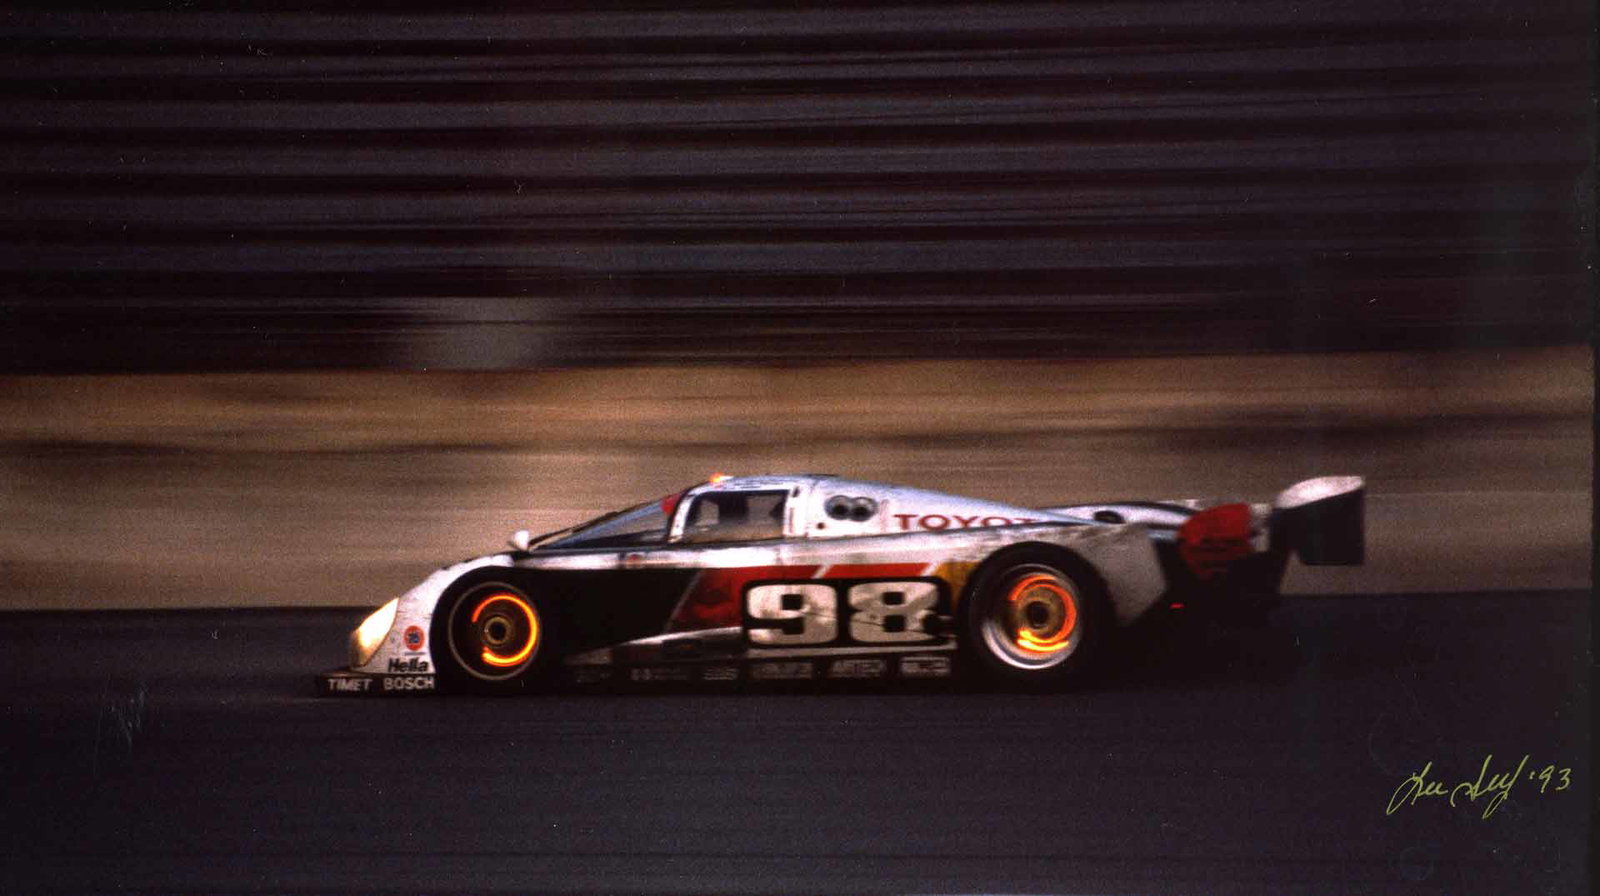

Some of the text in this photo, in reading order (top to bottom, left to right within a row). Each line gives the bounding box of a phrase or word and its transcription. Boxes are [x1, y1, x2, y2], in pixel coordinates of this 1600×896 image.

[746, 582, 942, 645] 98
[388, 656, 430, 673] Hella
[327, 677, 435, 691] TIMET BOSCH
